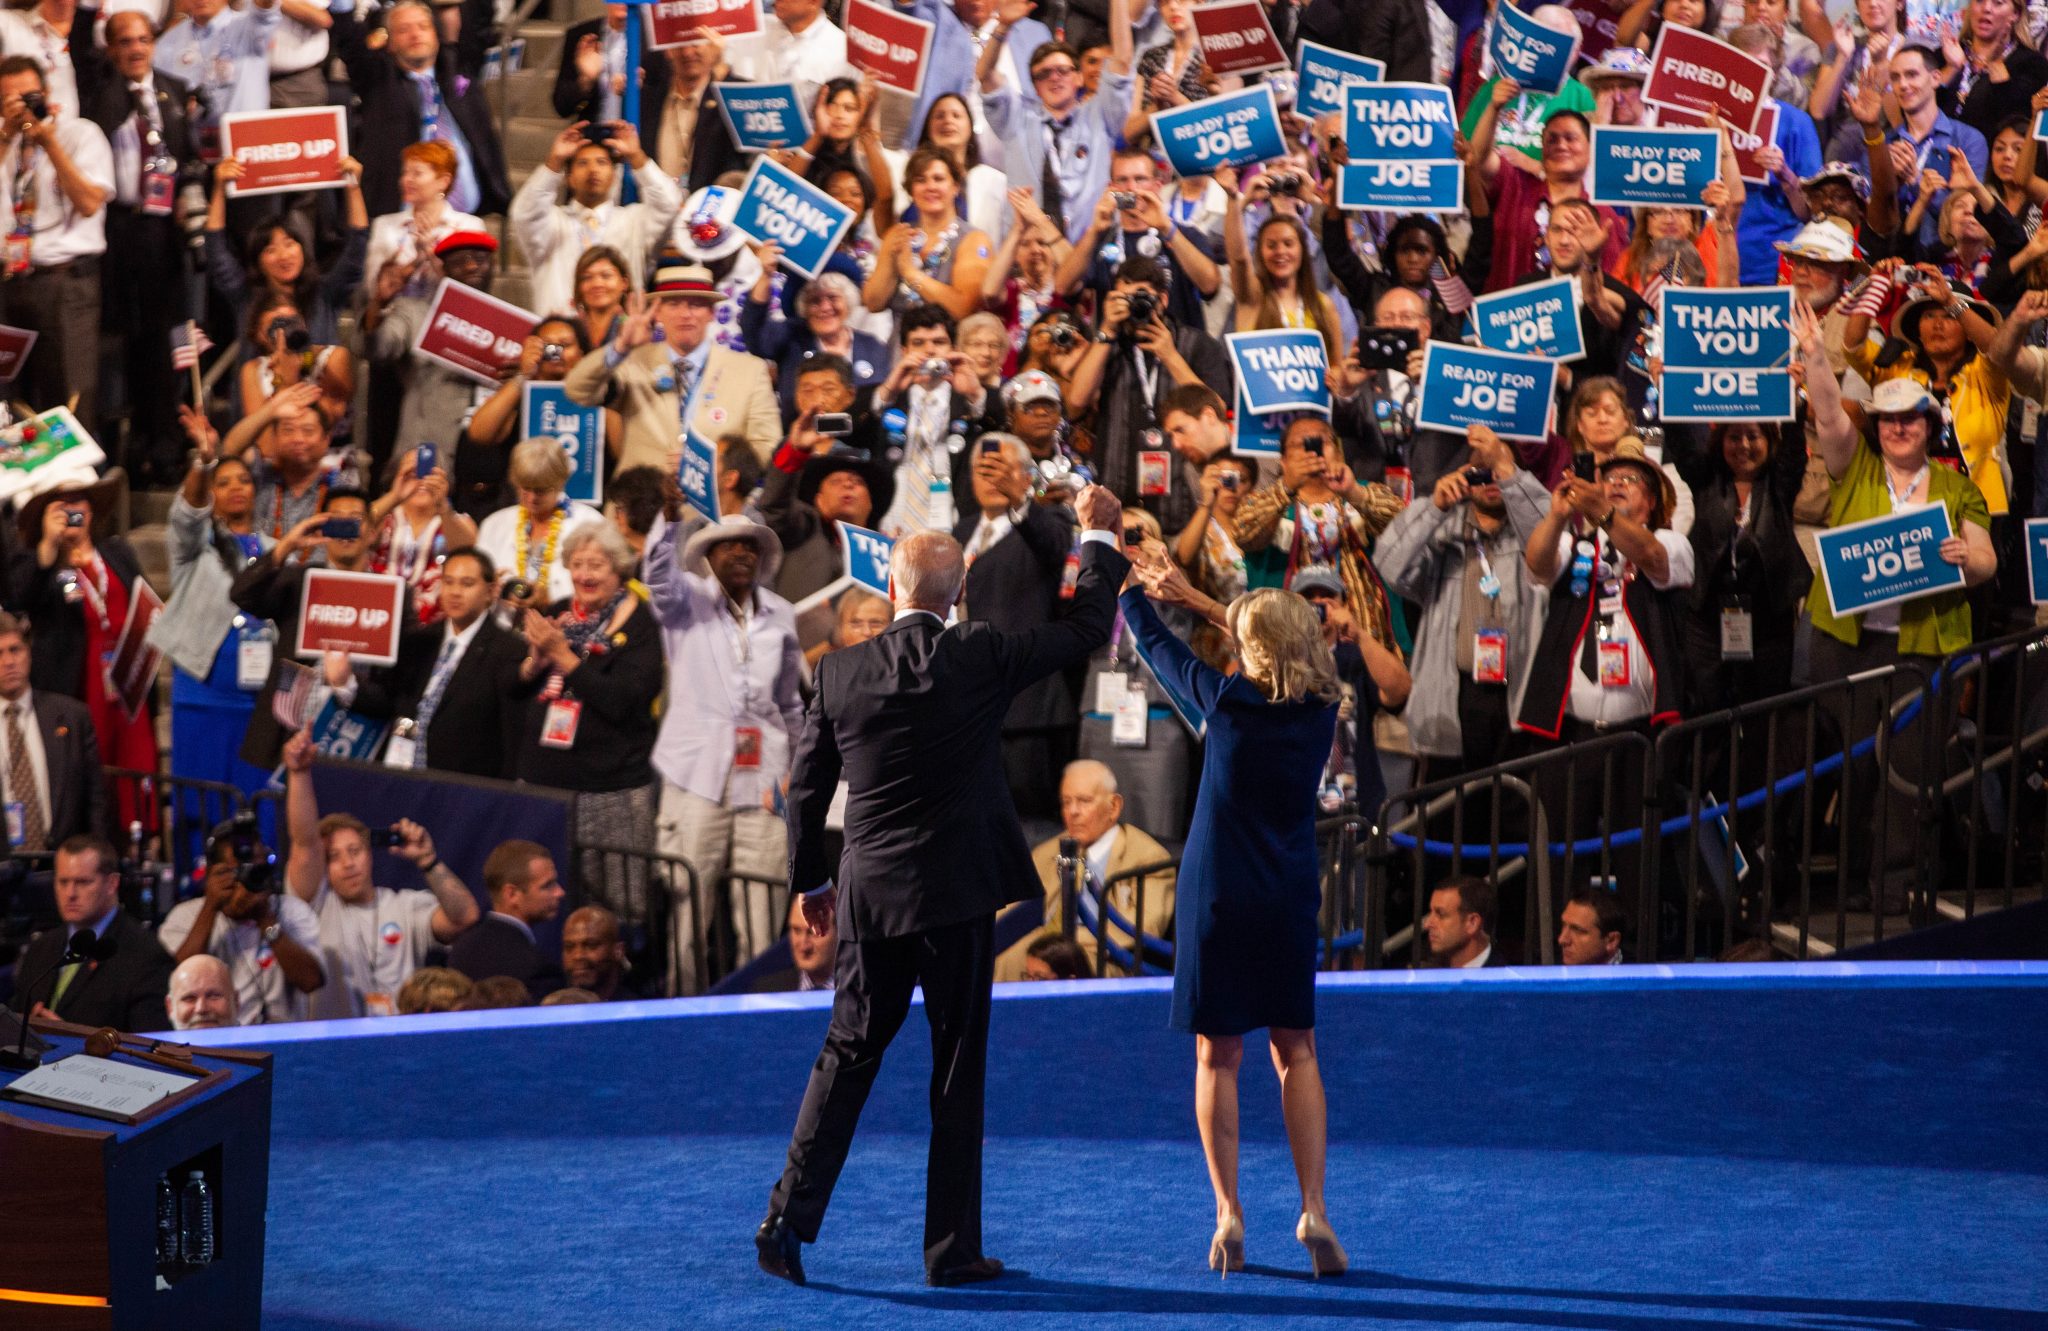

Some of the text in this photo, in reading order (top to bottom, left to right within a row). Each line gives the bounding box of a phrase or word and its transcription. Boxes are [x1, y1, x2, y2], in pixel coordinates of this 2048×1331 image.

[1200, 26, 1268, 52] FIRED UP
[1525, 36, 1557, 57] FOR
[889, 42, 918, 64] UP
[1497, 34, 1539, 74] JOE
[1309, 78, 1341, 103] JO
[1661, 56, 1755, 104] FIRED UP
[728, 97, 790, 110] READY FOR
[1352, 99, 1450, 123] THANK
[743, 110, 786, 133] JOE
[1172, 106, 1260, 141] READY FOR
[1194, 123, 1253, 161] JOE
[1369, 123, 1434, 148] YOU
[1731, 130, 1764, 152] UP
[235, 138, 337, 164] FIRED UP
[1610, 144, 1702, 162] READY FOR
[1369, 163, 1433, 188] JOE
[1623, 161, 1687, 186] JOE
[752, 173, 838, 240] THANK
[754, 202, 807, 247] YOU
[1489, 297, 1563, 328] READY FOR
[1671, 303, 1782, 330] THANK
[435, 311, 524, 359] FIRED UP
[1504, 314, 1556, 350] JOE
[1692, 330, 1760, 356] YOU
[1242, 344, 1326, 372] THANK
[1266, 368, 1320, 393] YOU
[1442, 362, 1536, 390] READY FOR
[1694, 371, 1759, 397] JOE
[1453, 382, 1519, 414] JOE
[541, 400, 557, 432] FOR
[680, 462, 707, 498] JOE
[1839, 525, 1934, 562] READY FOR
[1861, 545, 1925, 583] JOE
[308, 603, 390, 630] FIRED UP
